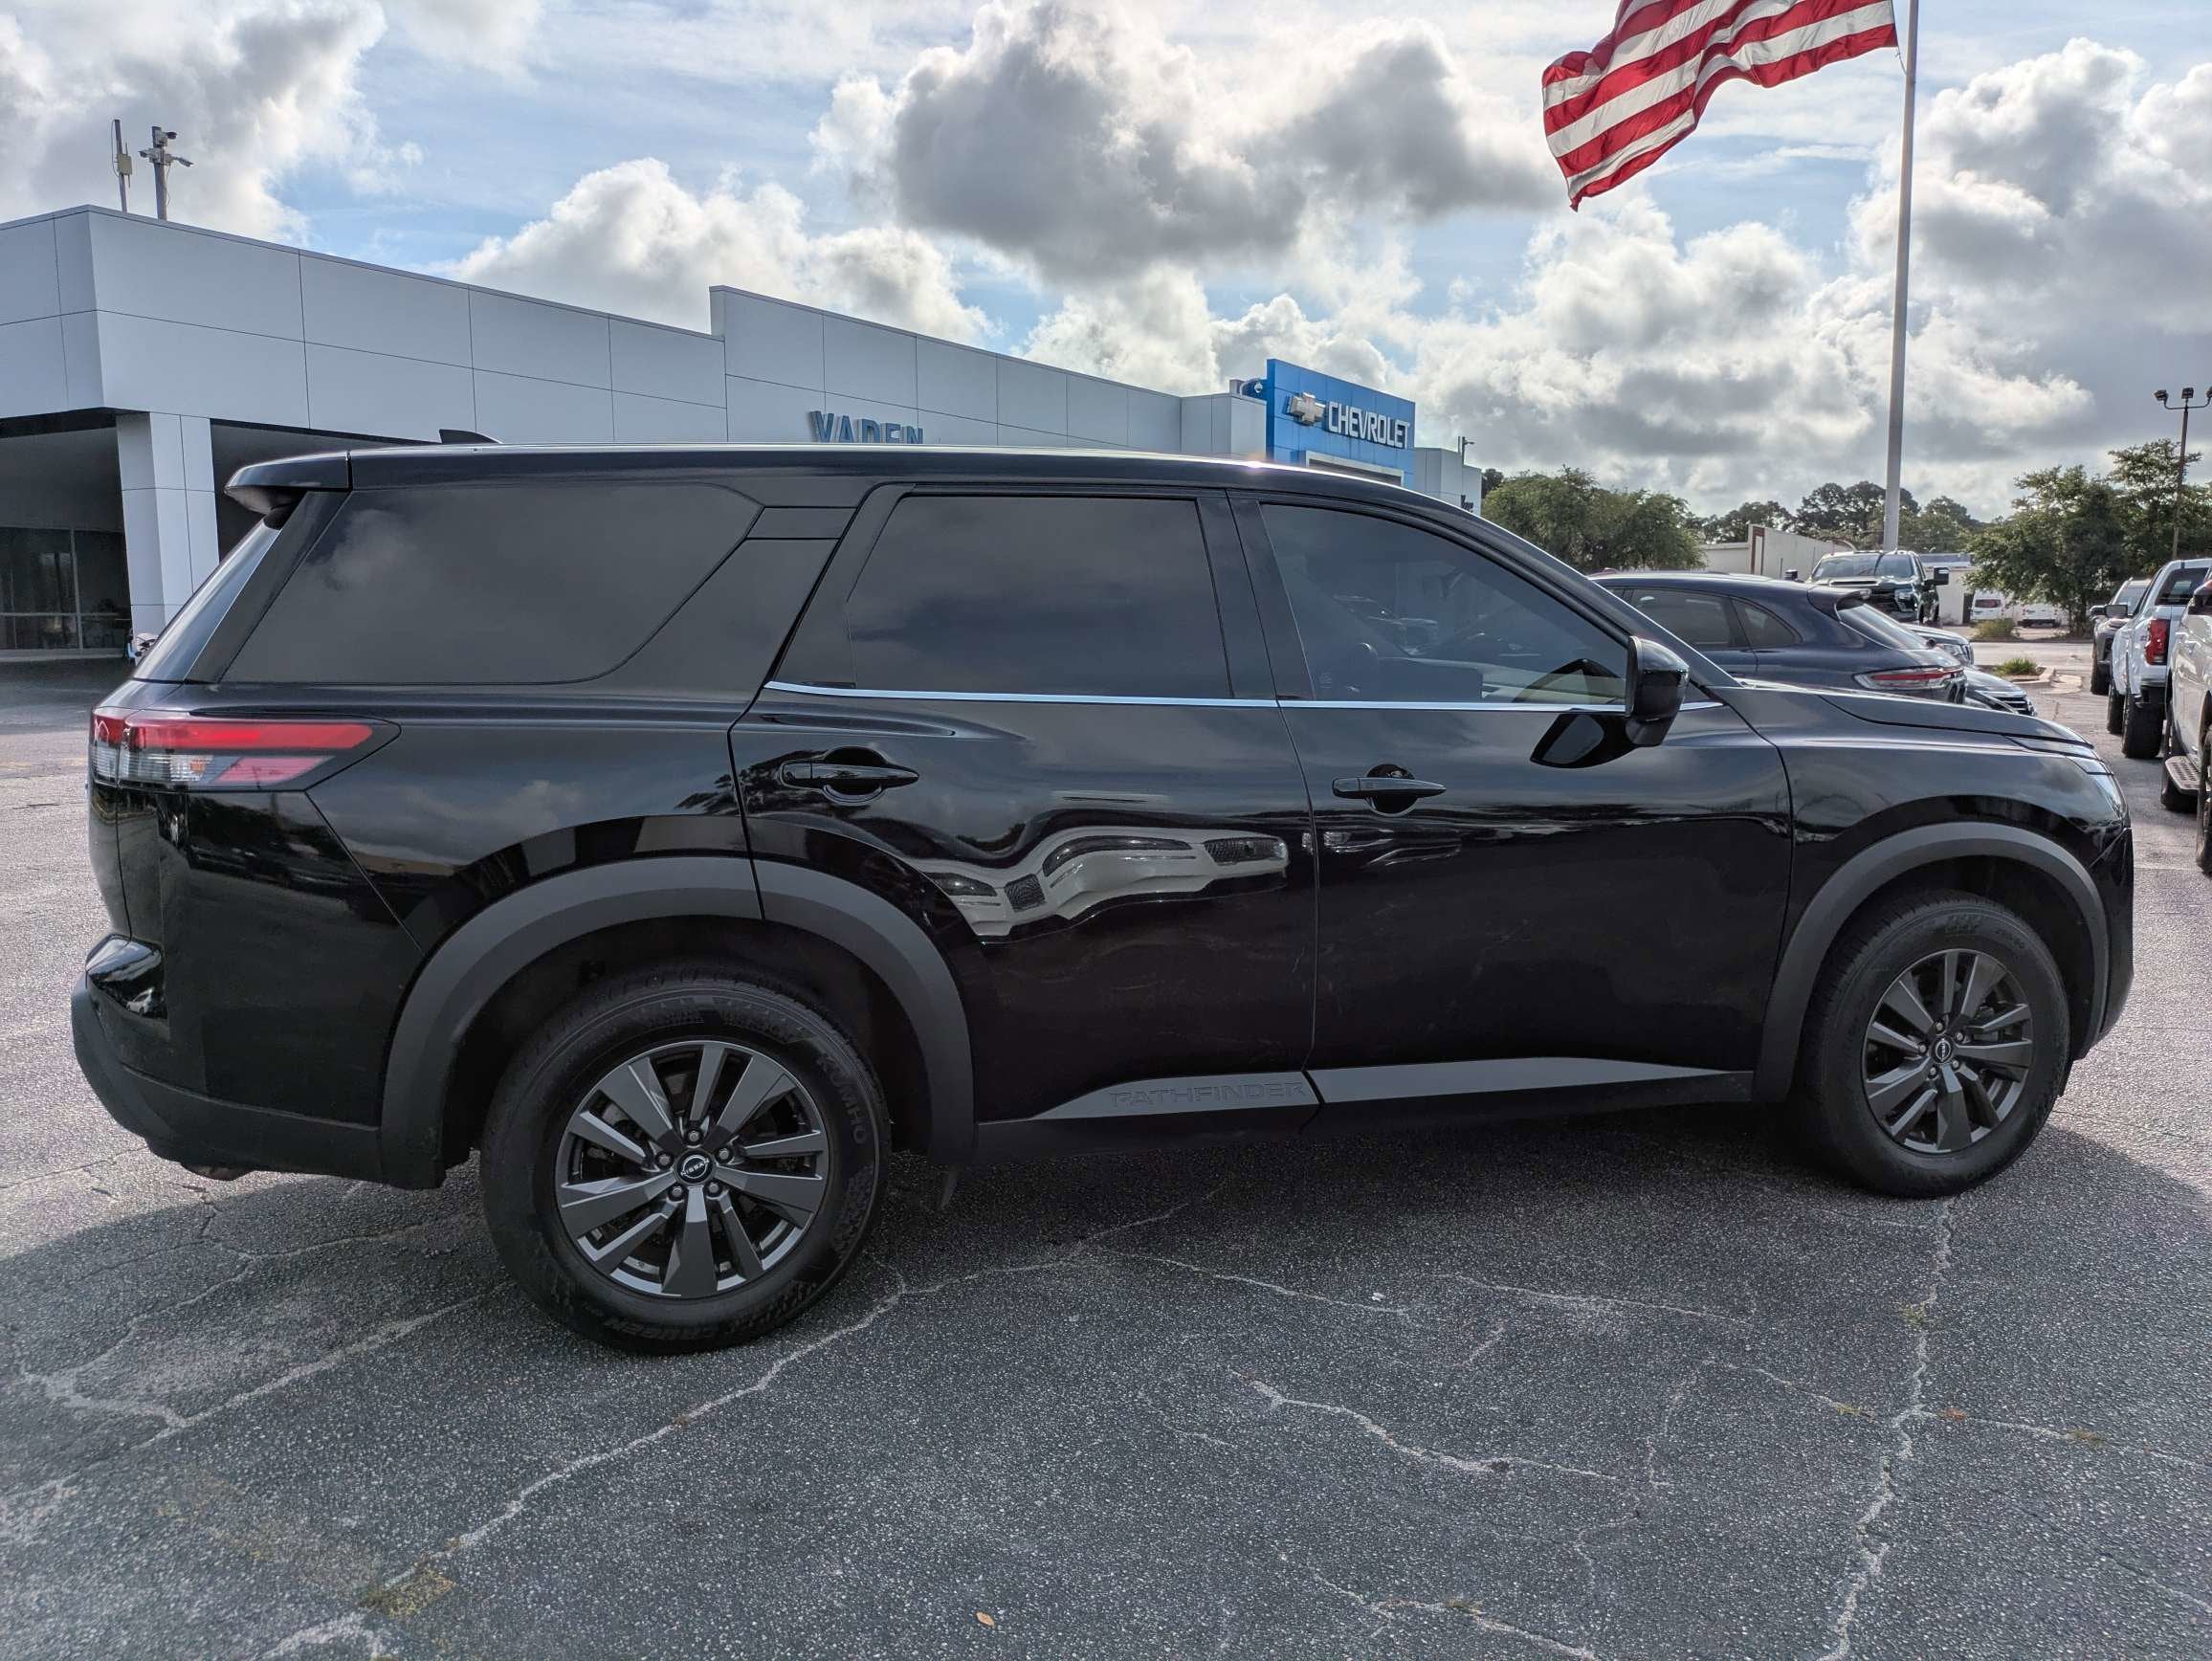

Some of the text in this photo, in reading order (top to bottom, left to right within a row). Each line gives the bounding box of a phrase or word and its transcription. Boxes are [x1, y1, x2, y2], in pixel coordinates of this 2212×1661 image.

[808, 410, 923, 444] VADEN
[1328, 401, 1410, 450] CHEVROLET
[1109, 1081, 1307, 1108] PATHFINDER
[679, 1157, 711, 1177] NISSAN
